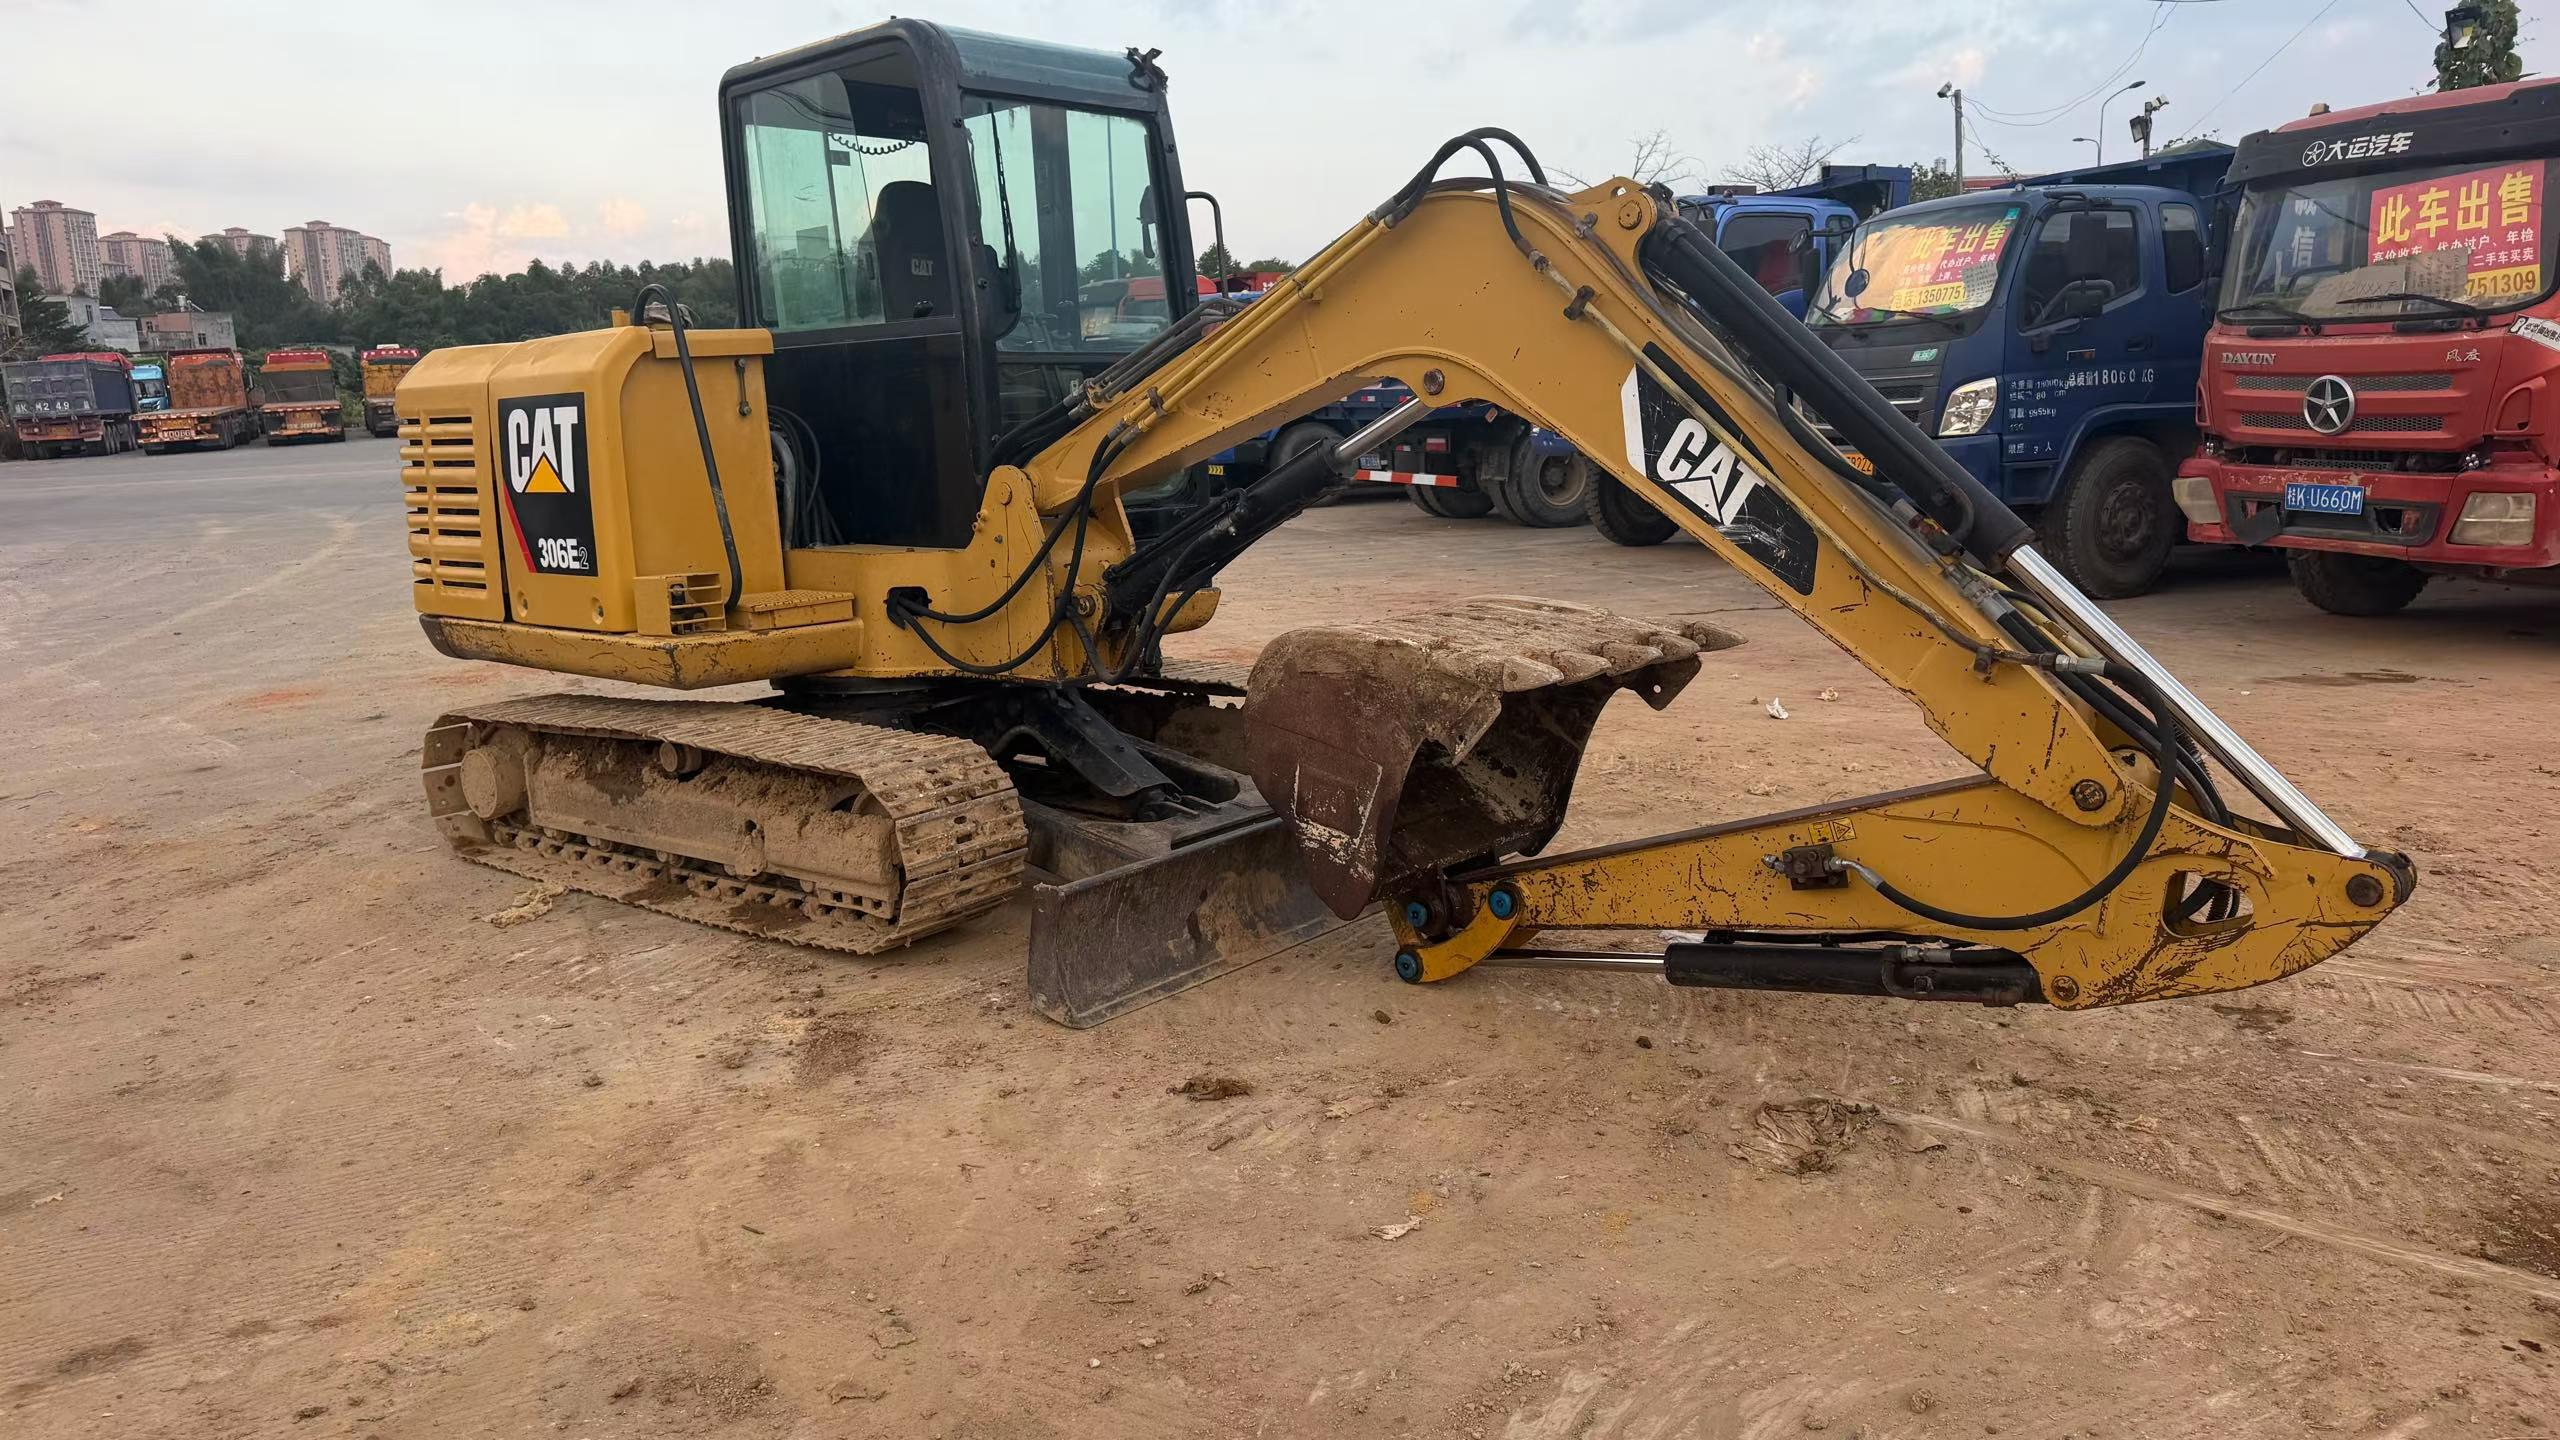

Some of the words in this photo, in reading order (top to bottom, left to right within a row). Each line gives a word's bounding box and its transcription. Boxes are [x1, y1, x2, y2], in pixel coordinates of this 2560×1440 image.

[2324, 132, 2414, 161] 大运汽车
[2377, 170, 2534, 245] 此车出售
[911, 258, 934, 276] CAT
[2222, 352, 2276, 365] DAYUN
[508, 406, 578, 493] CAT
[1656, 418, 1767, 526] CAT
[538, 537, 589, 570] 306E2
